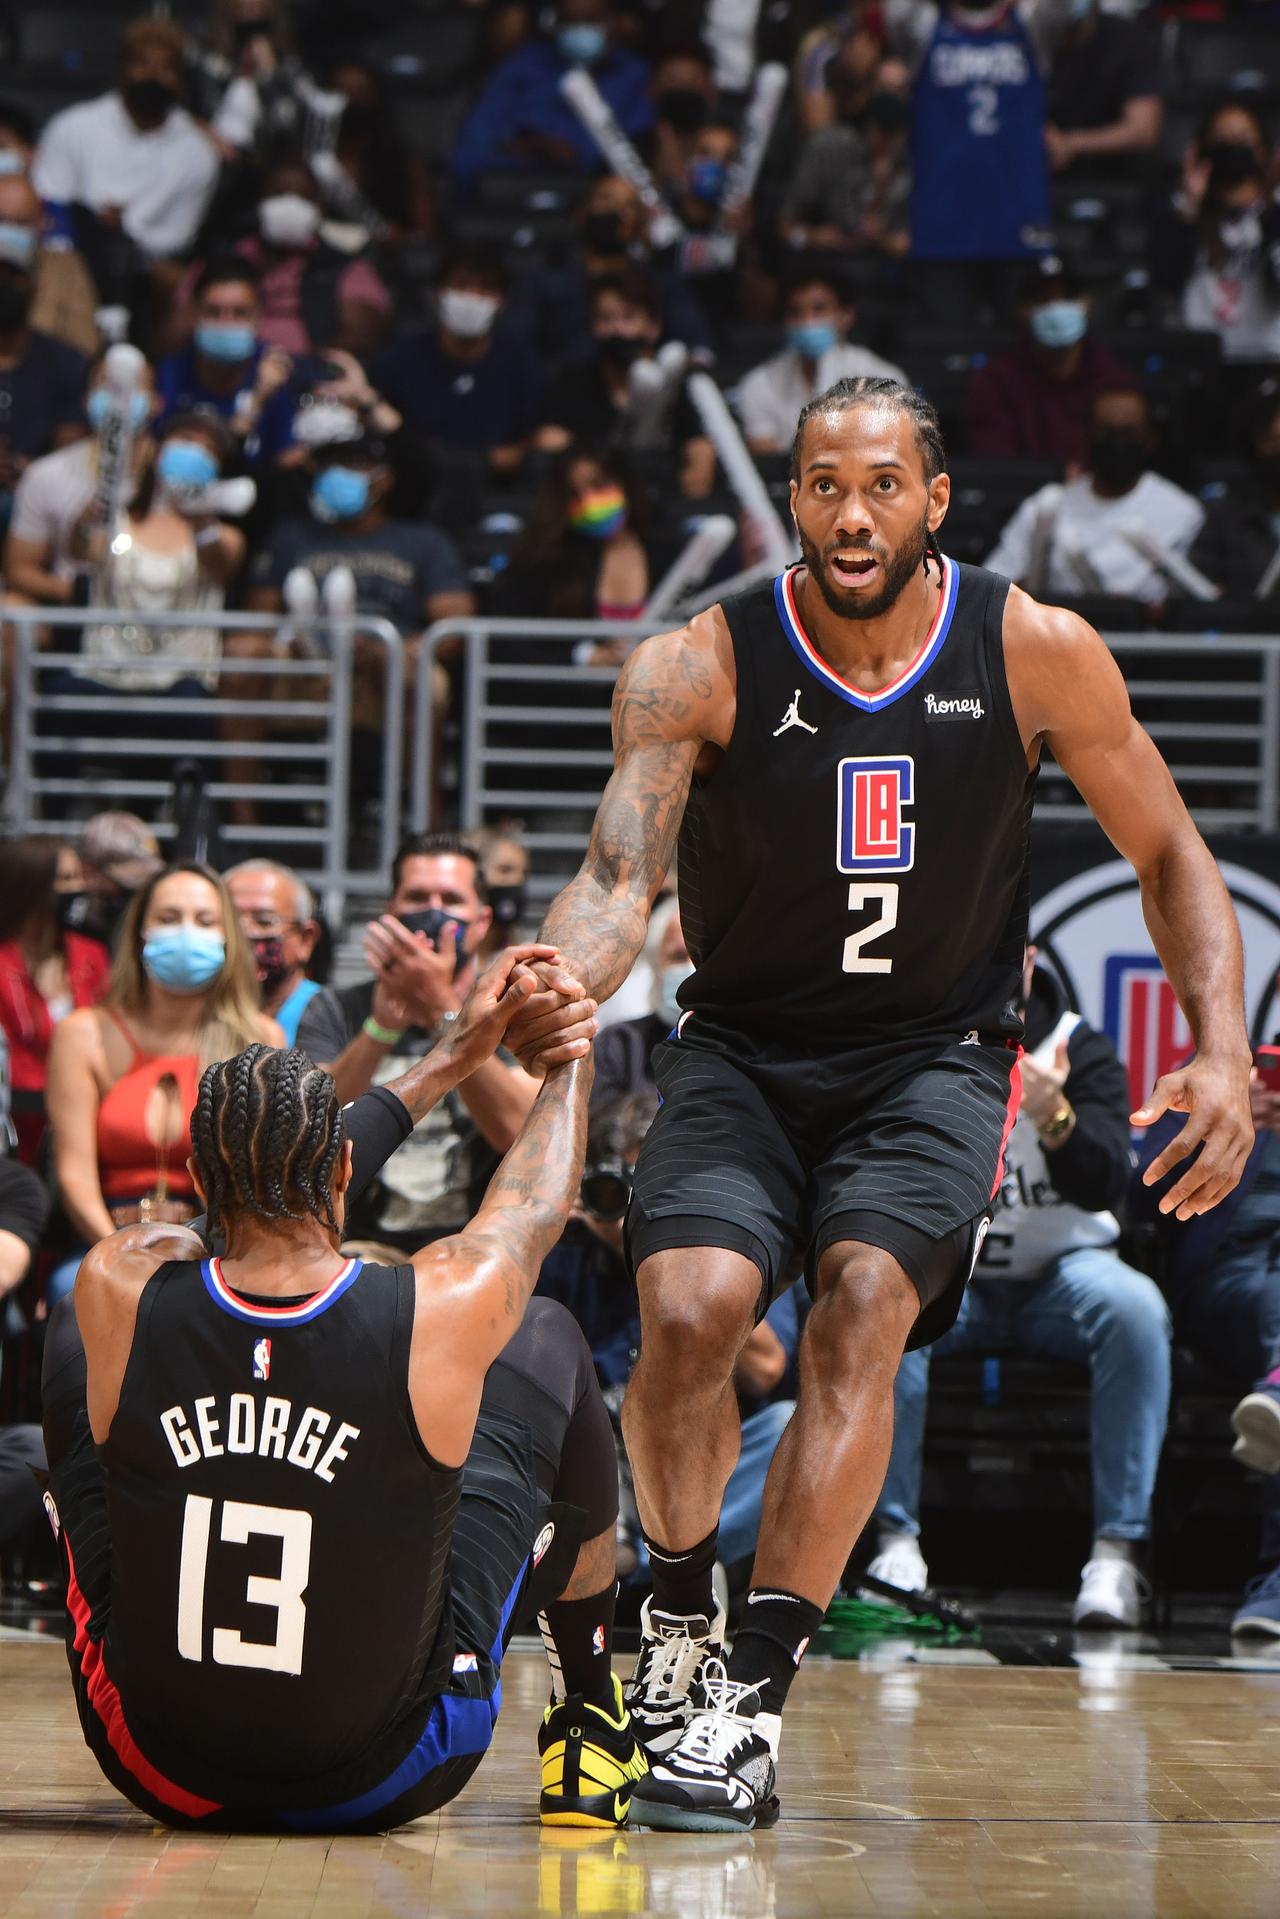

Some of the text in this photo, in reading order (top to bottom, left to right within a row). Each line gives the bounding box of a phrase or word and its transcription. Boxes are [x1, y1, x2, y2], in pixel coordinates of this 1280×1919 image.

[924, 693, 985, 719] honey
[842, 883, 899, 974] 2
[160, 1393, 361, 1483] GEORGE
[178, 1493, 313, 1676] 13
